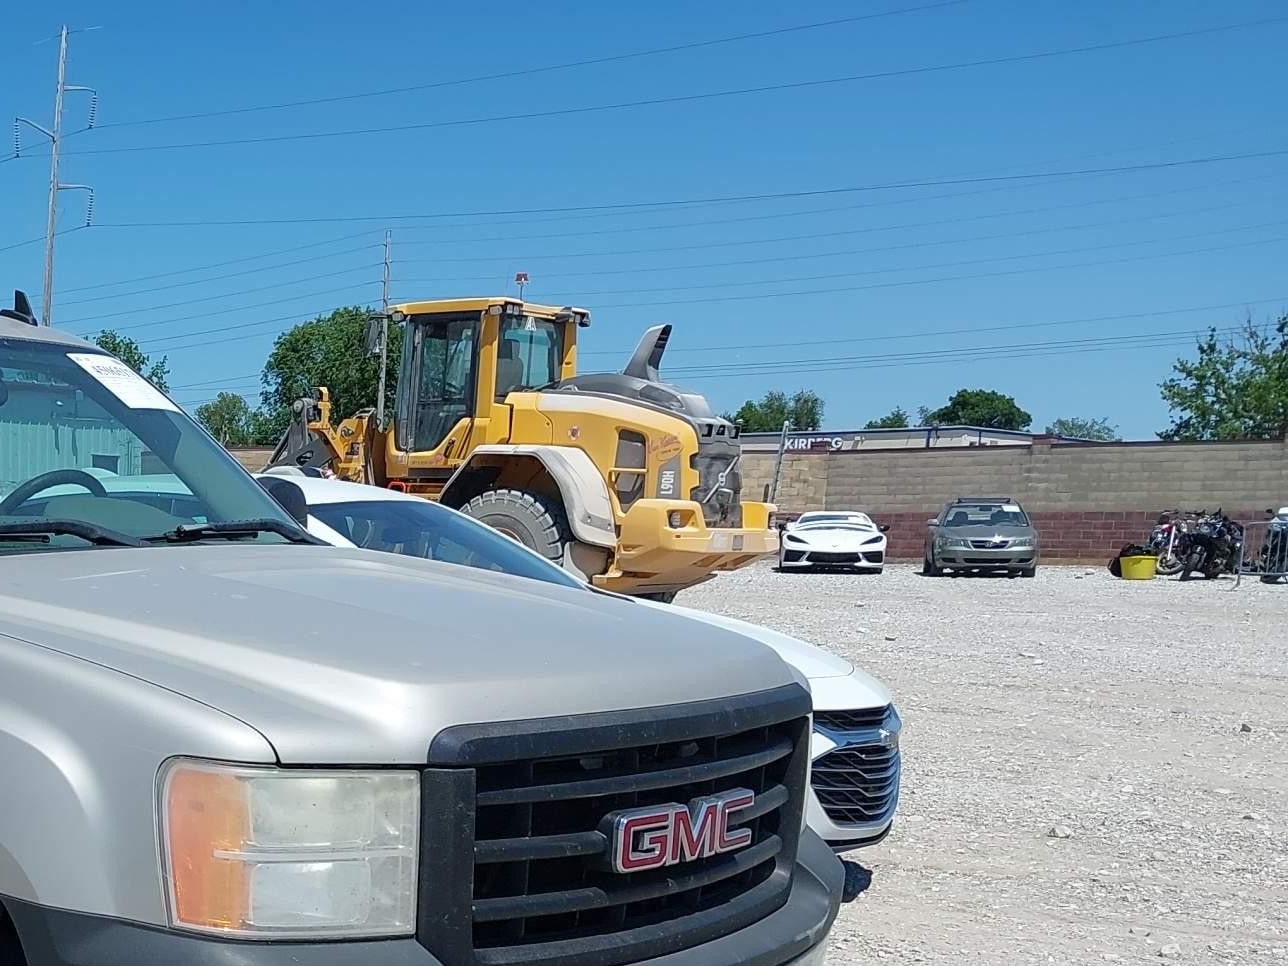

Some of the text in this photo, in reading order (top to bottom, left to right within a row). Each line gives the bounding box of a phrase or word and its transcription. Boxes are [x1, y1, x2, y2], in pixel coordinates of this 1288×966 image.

[785, 437, 843, 450] KIRG
[660, 470, 675, 495] L90H
[616, 788, 755, 874] GMC
